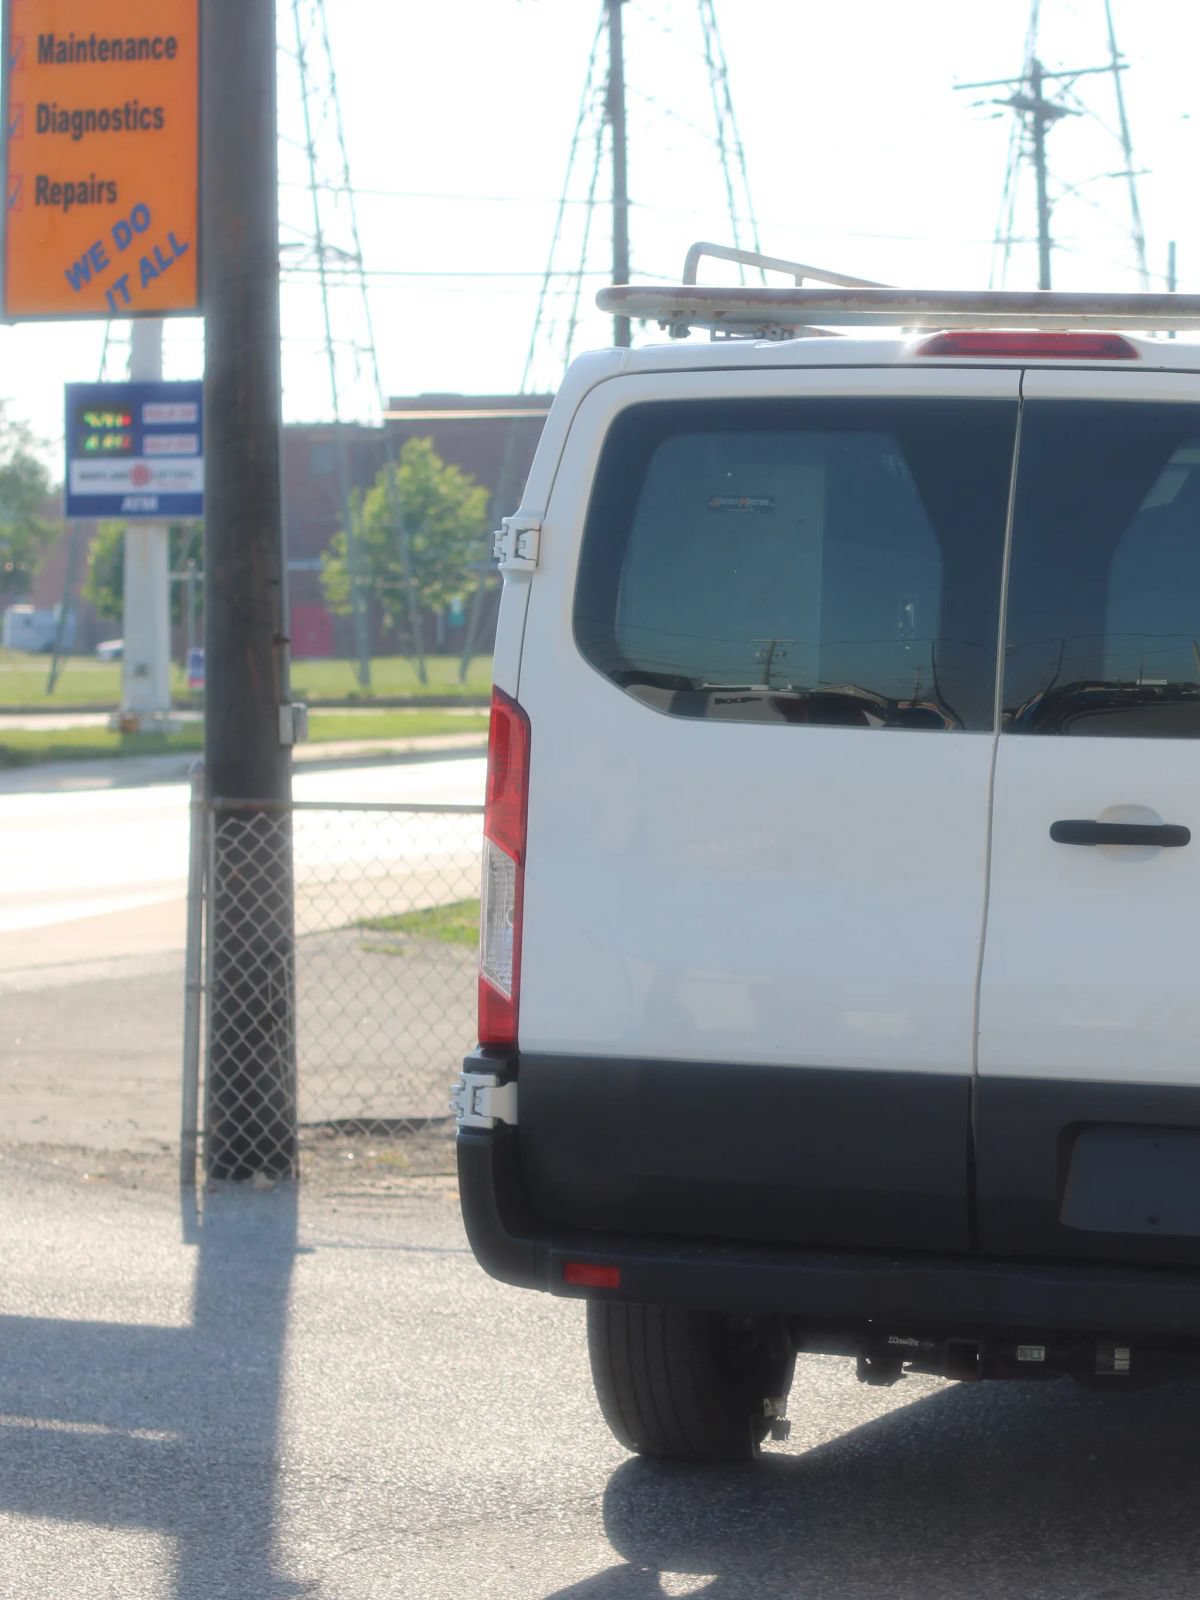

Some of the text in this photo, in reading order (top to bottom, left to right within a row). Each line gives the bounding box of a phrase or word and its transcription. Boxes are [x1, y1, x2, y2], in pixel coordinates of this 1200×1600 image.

[37, 33, 178, 64] Maintenance
[36, 100, 165, 141] Diagnostics
[35, 173, 118, 213] Repairs
[64, 203, 152, 292] WE DO
[104, 231, 190, 313] IT ALL
